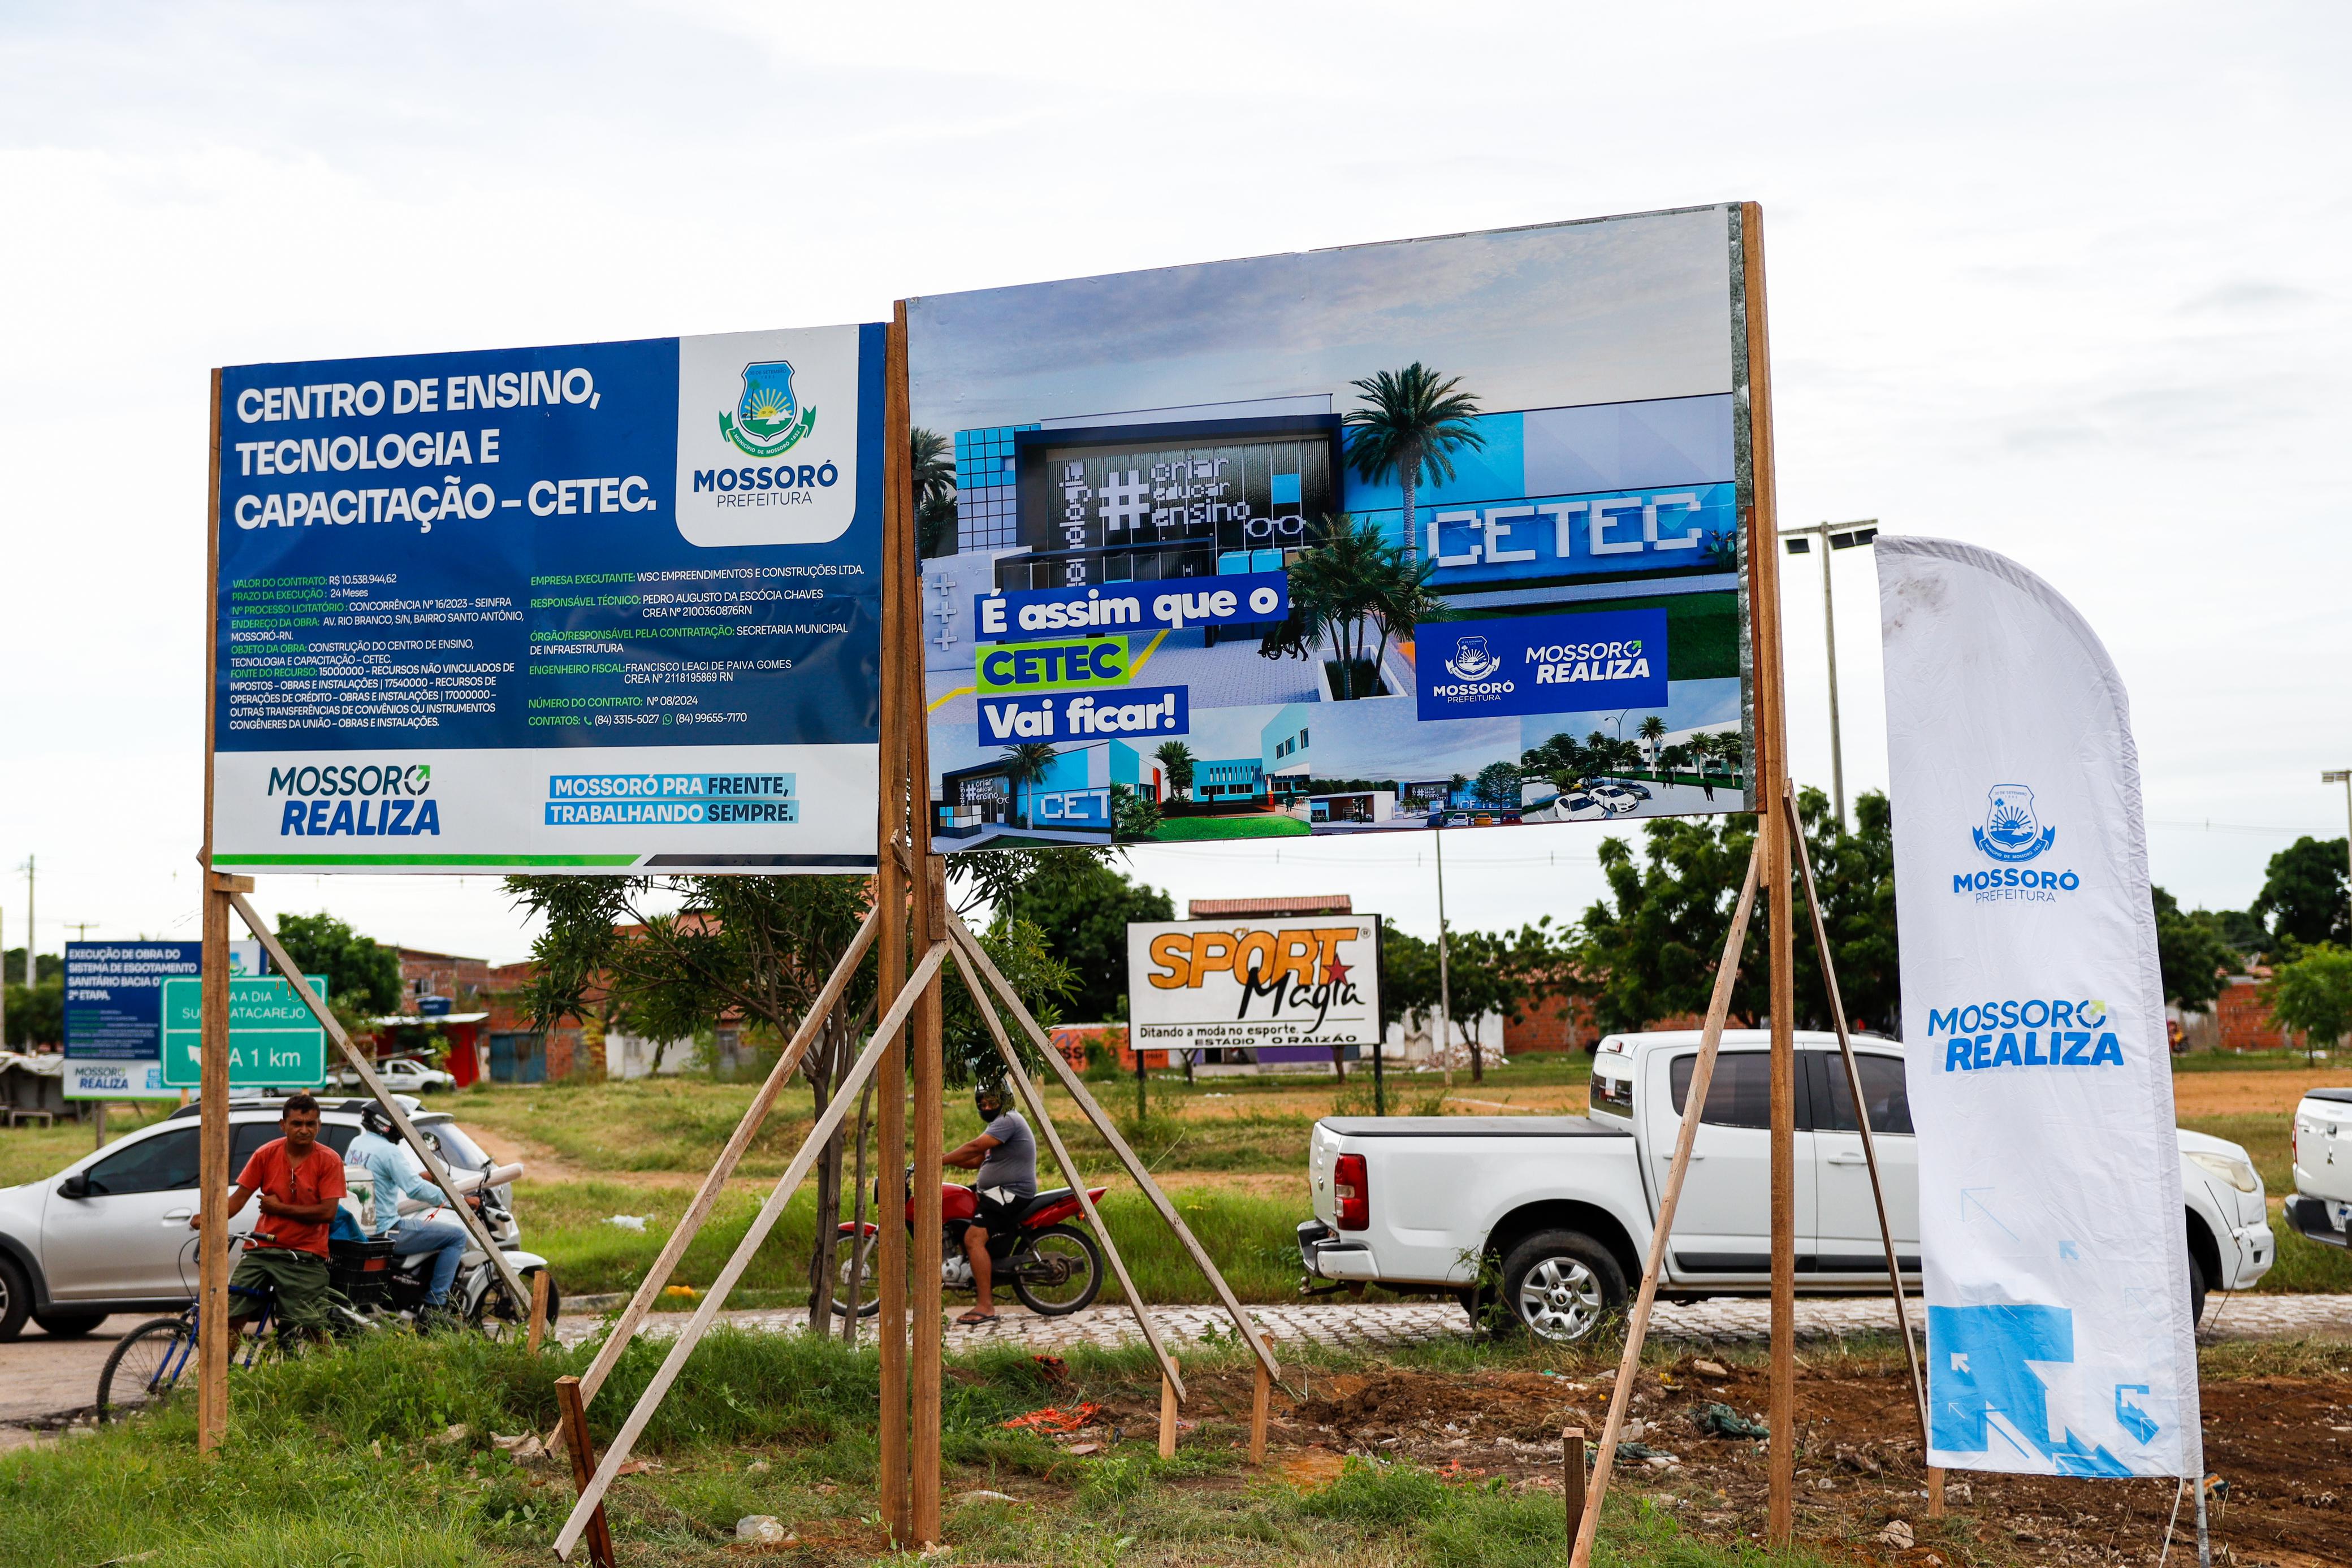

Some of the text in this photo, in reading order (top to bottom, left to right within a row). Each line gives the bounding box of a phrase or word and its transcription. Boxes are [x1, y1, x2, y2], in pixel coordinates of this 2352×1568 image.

[237, 368, 600, 423] CENTRO DE ENSINO,
[790, 430, 801, 442] 1852
[236, 429, 499, 475] TECNOLOGIA E
[694, 459, 838, 491] MOSSORÓ
[235, 475, 656, 534] CAPACITAÇÃO CETEC.
[717, 491, 812, 508] PREFEITURA
[1152, 498, 1251, 527] ensino
[1426, 492, 1702, 568] CETEC
[232, 573, 396, 588] VALOR DO CONTRATO: R$ 10.538.944,62
[531, 564, 864, 585] EMPRESA EXECUTANTE: WSC EMPREENDIMENTOS E CONSTRUÇÕES LTDA.
[232, 591, 261, 601] PRAZO
[262, 591, 274, 600] DA
[331, 588, 341, 597] 24
[343, 588, 368, 597] Meses
[531, 589, 823, 608] RESPONSÁVEL TÉCNICO: PEDRO AUGUSTO DA ESCÓCIA CHAVES
[244, 604, 290, 614] PROCESSO
[349, 599, 421, 611] CONCORRÊNCIA
[435, 599, 467, 608] 16/2023
[475, 597, 511, 607] SEINFRA
[642, 608, 667, 617] CREA
[682, 605, 751, 616] 2100360876RN
[983, 588, 1277, 633] É assim que o
[231, 610, 524, 630] ENDEREÇO DA OBRA: AV. RIO BRANCO, S/N, BAIRRO SANTO ANTÔNIO,
[231, 629, 293, 641] MOSSORÓ-RN.
[530, 623, 848, 641] ÓRGÃO/RESPONSÁVEL PELA CONTRATAÇÃO: SECRETARIA MUNICIPAL
[231, 639, 473, 654] OBJETO DA OBRA: CONSTRUÇÃO DO CENTRO DE ENSINO,
[530, 643, 624, 655] DE INFRAESTRUTURA
[231, 654, 392, 666] TECNOLOGIA E CAPACITAÇÃO CETEC.
[982, 643, 1122, 686] CETEC
[231, 662, 514, 678] FONTE DO RECURSO: 15000000 RECURSOS NÃO VINCULADOS DE
[1536, 657, 1650, 685] REALIZA
[1433, 680, 1515, 696] MOSSORÓ
[529, 696, 569, 708] NÚMERO
[572, 698, 586, 707] DO
[587, 697, 642, 707] CONTRATO:
[660, 695, 698, 705] 08/2024
[1447, 695, 1501, 704] PREFEITURA
[529, 716, 580, 725] CONTATOS:
[595, 714, 659, 726] (84) 3315-5027
[676, 712, 747, 725] (84) 99655-7170
[984, 694, 1175, 738] Vai ficar!
[555, 774, 789, 798] MOSSORÓ PRA FRENTE,
[280, 799, 441, 836] REALIZA
[551, 801, 794, 824] TRABALHANDO SEMPRE.
[1953, 868, 2079, 893] MOSSORÓ
[1975, 889, 2057, 903] PREFEITURA
[68, 946, 180, 961] EXECUÇÃO DE OBRA DO
[1148, 927, 1359, 989] SPORT
[68, 963, 197, 973] SISTEMA DE ESGOTAMENTO
[68, 973, 151, 987] SANITÁRIO BACIA
[252, 991, 273, 1002] DIA
[1140, 1026, 1183, 1038] Ditando
[1197, 1025, 1225, 1036] moda
[229, 1047, 301, 1067] A 1 km
[1945, 1032, 2125, 1072] REALIZA
[80, 1078, 128, 1089] REALIZA
